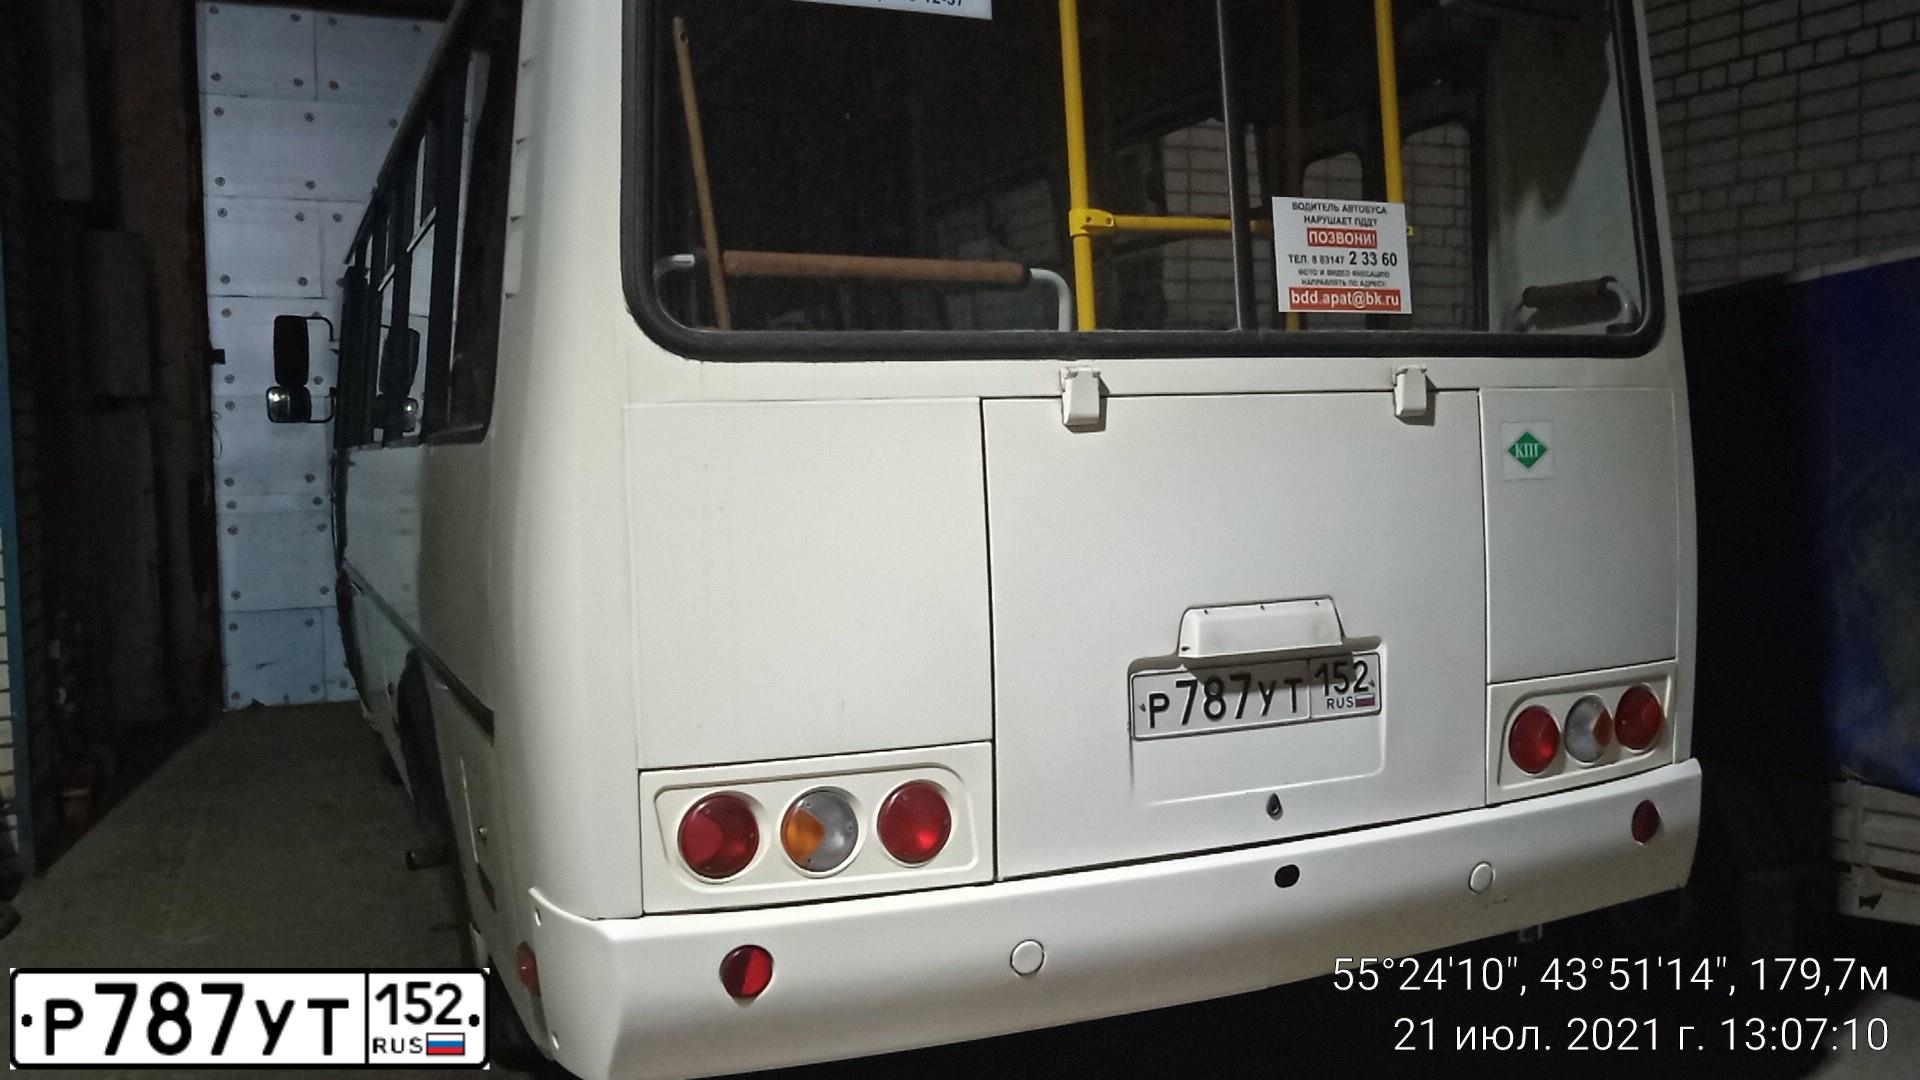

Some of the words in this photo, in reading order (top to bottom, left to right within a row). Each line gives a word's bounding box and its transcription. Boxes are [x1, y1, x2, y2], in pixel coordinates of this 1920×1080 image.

[1292, 202, 1340, 212] ВОДИТЕЛЬ
[1342, 205, 1387, 214] АВТОБУСА
[1304, 215, 1352, 225] НАРУШАЕТ
[1354, 218, 1377, 227] ПДД?
[1309, 231, 1376, 245] ПОЗВОНИ!
[1312, 255, 1317, 264] 8
[1349, 251, 1357, 265] 2
[1361, 252, 1377, 266] 33
[1382, 252, 1397, 266] 60
[1291, 290, 1399, 309] bdd.apat@bk.ru
[1148, 672, 1303, 729] Р787УТ
[1315, 660, 1369, 697] 152
[1326, 695, 1354, 710] RUS
